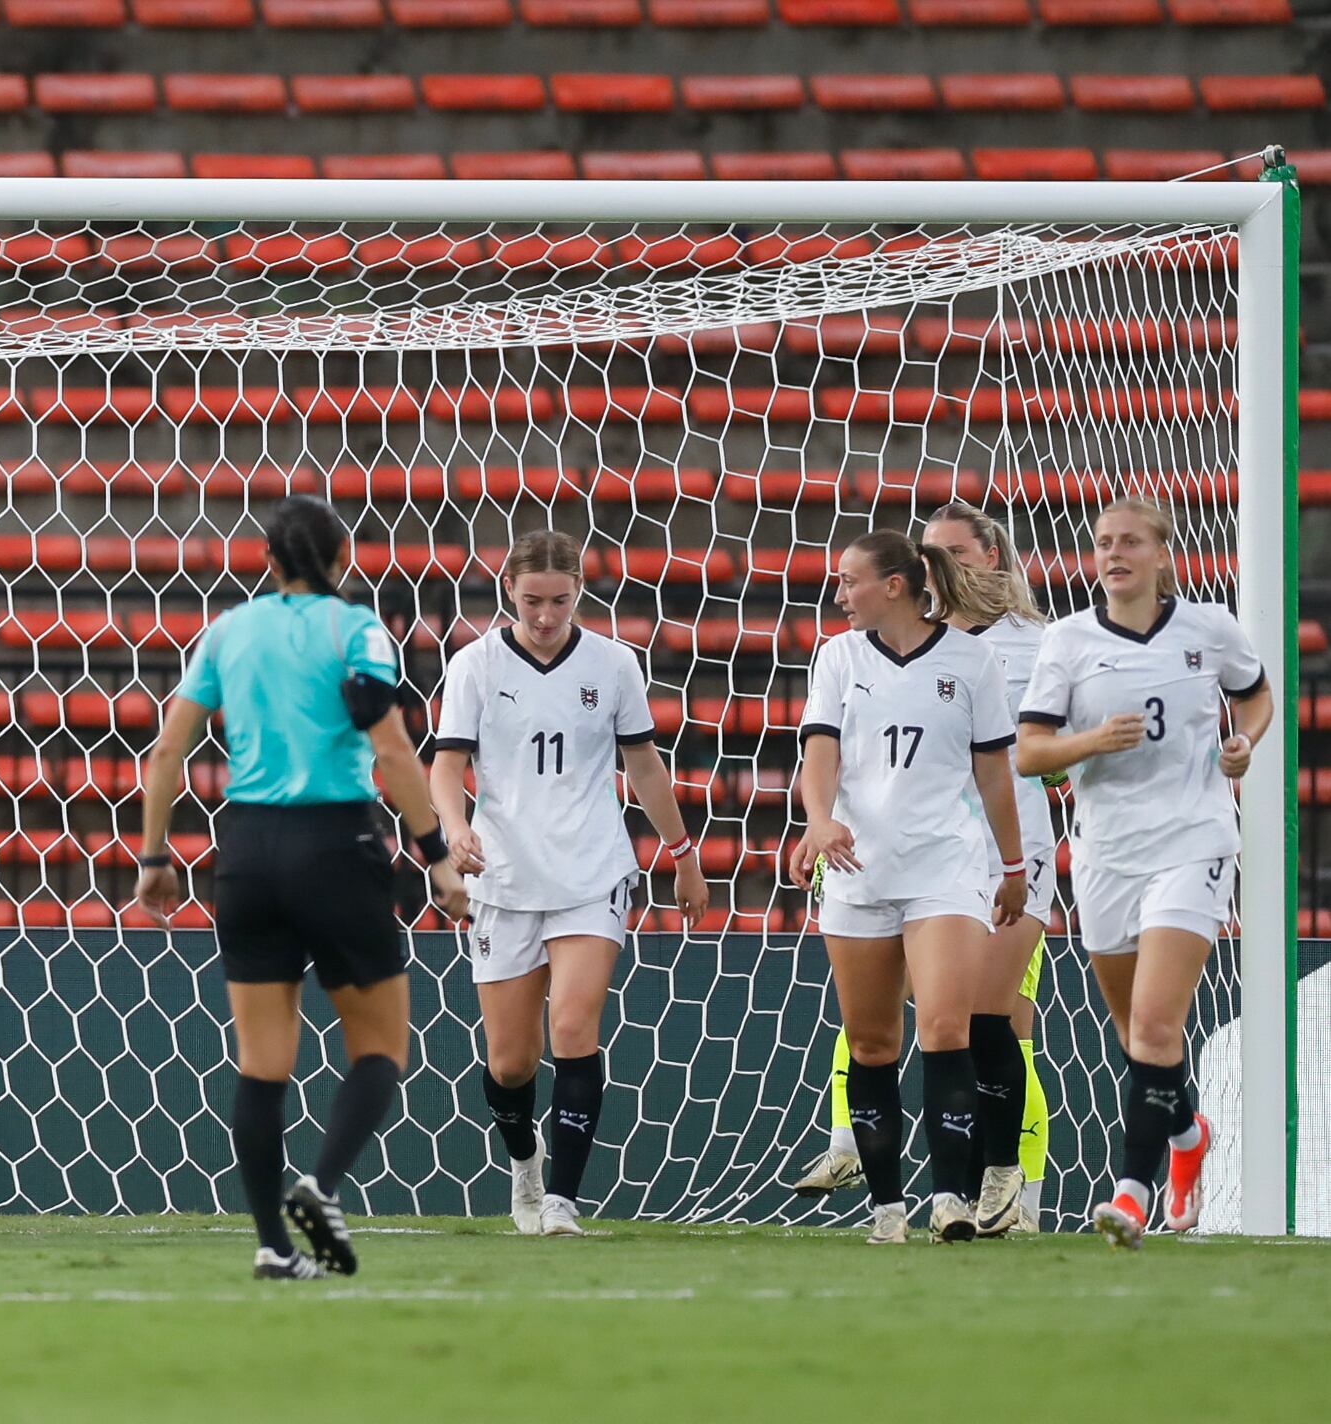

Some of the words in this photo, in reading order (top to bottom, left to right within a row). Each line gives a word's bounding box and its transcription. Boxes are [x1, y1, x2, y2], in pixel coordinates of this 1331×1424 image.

[1145, 697, 1165, 741] 3
[531, 731, 564, 775] 11
[883, 724, 925, 769] 17
